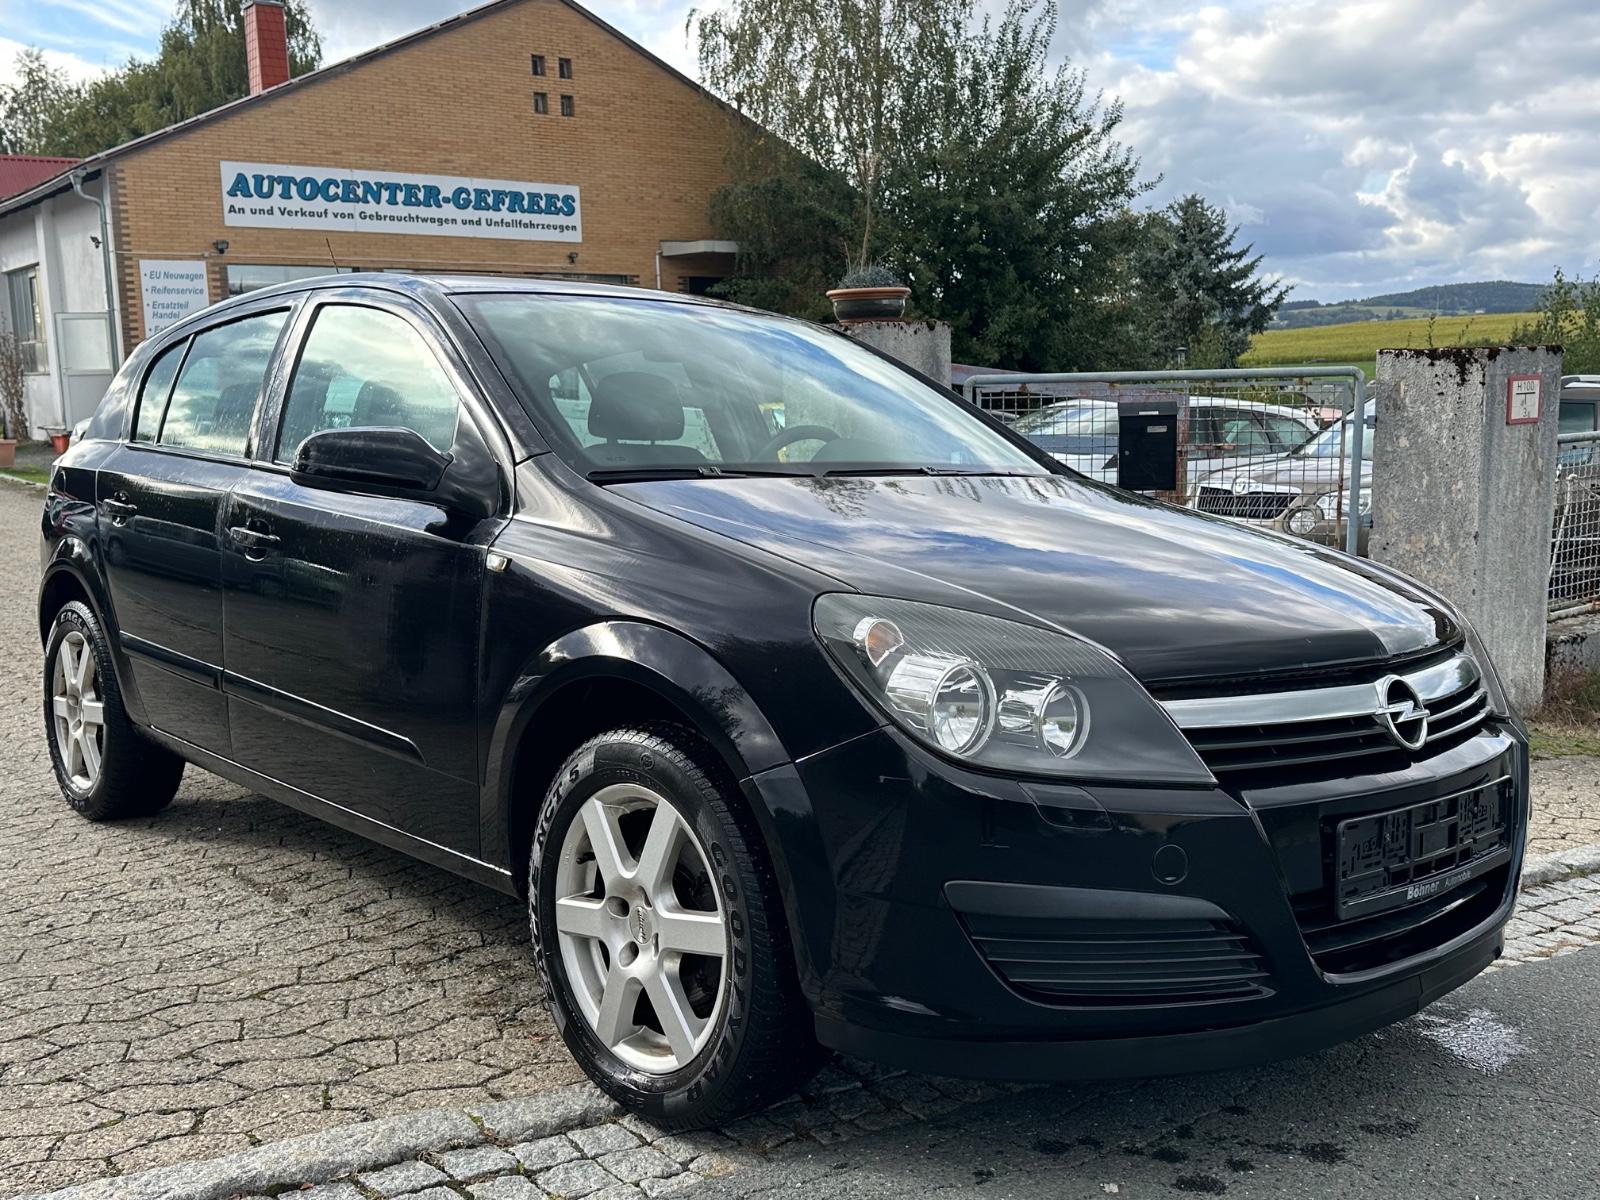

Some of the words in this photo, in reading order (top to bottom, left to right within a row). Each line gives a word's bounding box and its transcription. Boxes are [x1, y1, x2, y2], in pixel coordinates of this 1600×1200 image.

[226, 173, 577, 217] AUTOCENTER-GEFREES
[227, 204, 246, 215] An
[250, 205, 274, 216] und
[277, 206, 329, 219] Verkauf
[332, 211, 355, 220] von
[359, 210, 458, 227] Gebrauchtwagen
[461, 217, 482, 227] und
[485, 218, 577, 233] Unfallfahrzeugen
[149, 271, 161, 280] EU
[163, 271, 204, 282] Neuwagen
[150, 286, 204, 296] Reifenservice
[152, 300, 189, 310] Ersatzteil
[152, 311, 181, 320] Handel
